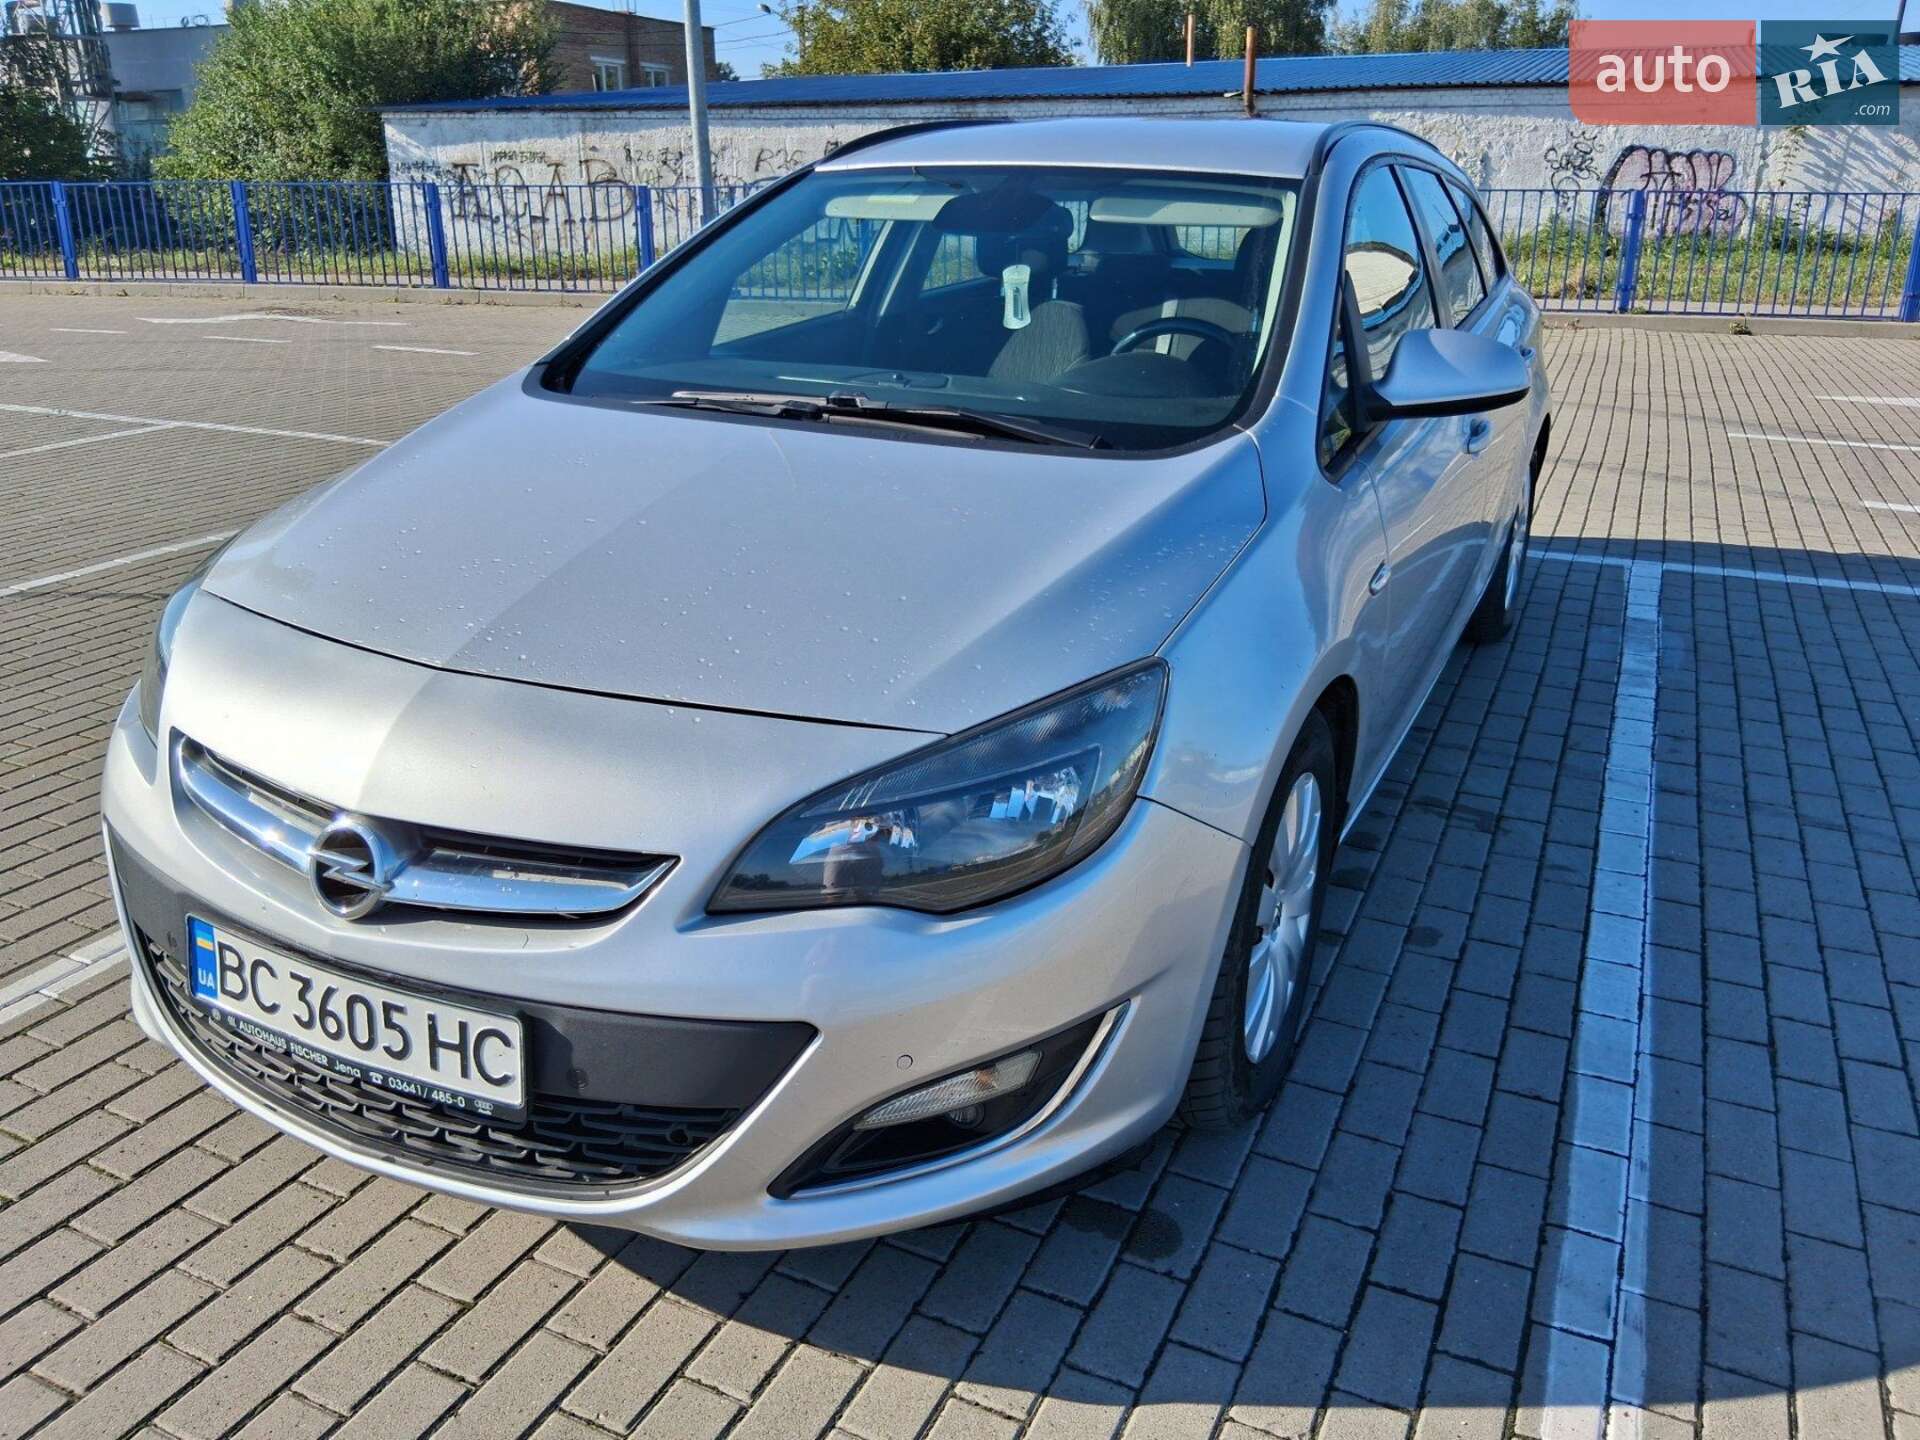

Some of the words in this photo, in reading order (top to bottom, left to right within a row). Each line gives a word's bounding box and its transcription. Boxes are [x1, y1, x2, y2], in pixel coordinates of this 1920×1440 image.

[198, 967, 216, 990] UA
[218, 941, 281, 1014] BC
[289, 970, 412, 1061] 3605
[427, 1013, 516, 1087] HC
[239, 1020, 287, 1049] AUTOHAUS
[290, 1042, 329, 1067] FISCHER
[334, 1060, 361, 1078] Jena
[431, 1090, 466, 1108] 485-0
